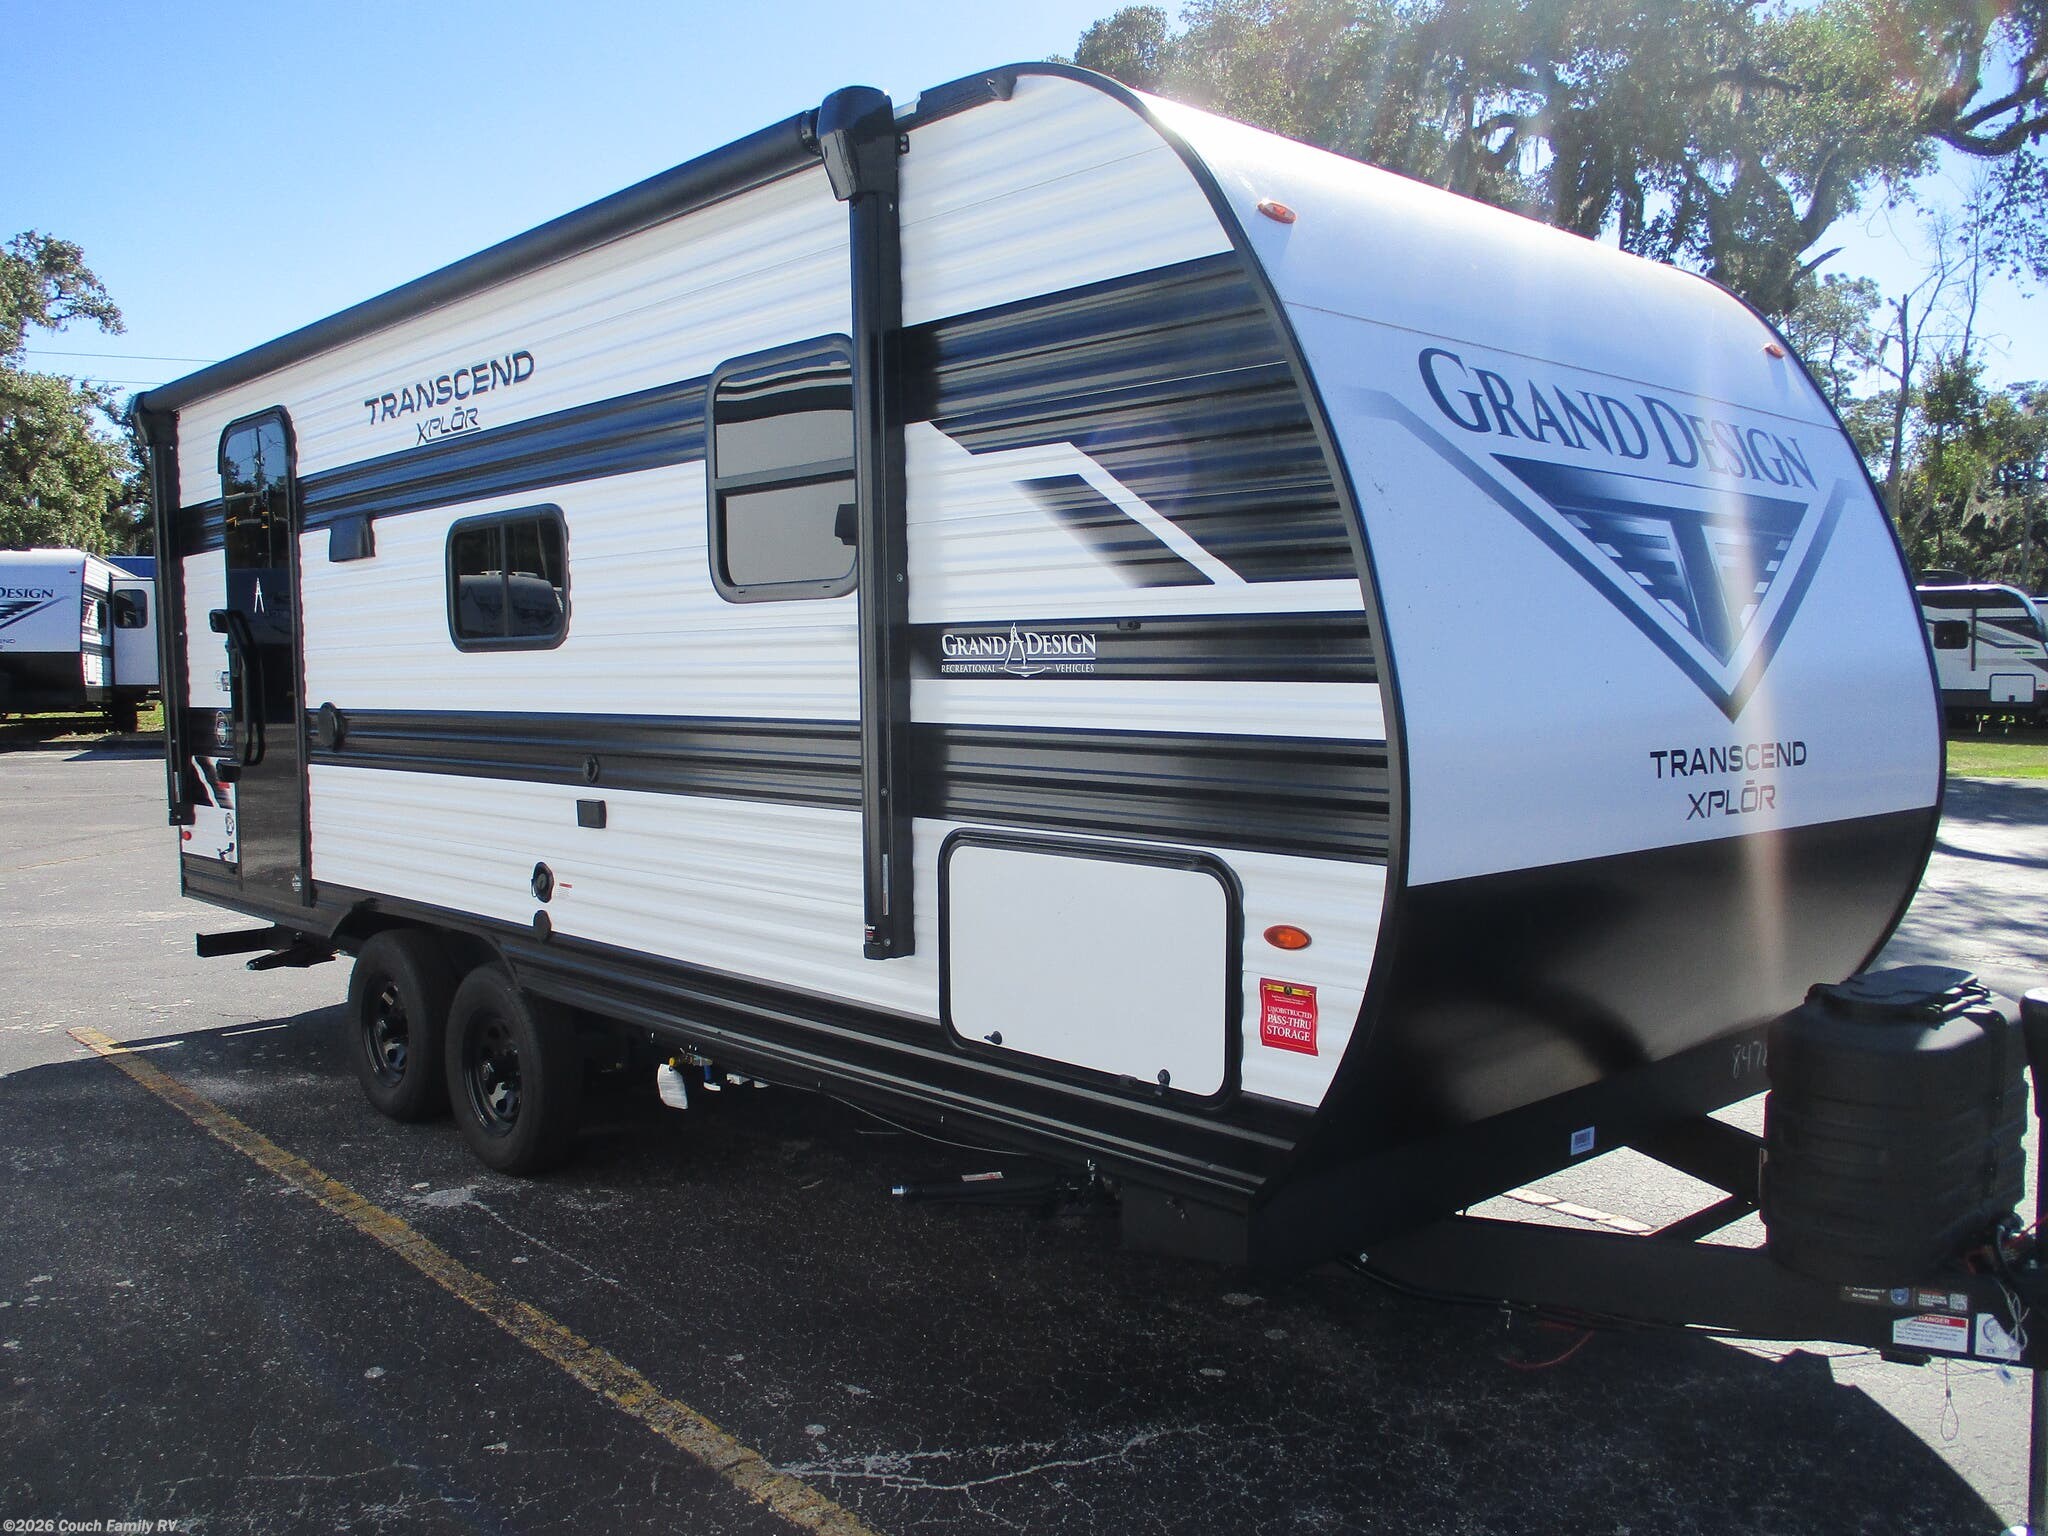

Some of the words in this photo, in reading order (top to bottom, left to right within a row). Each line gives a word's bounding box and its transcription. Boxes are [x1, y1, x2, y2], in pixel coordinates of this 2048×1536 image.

[364, 350, 535, 426] TRANSCEND
[1418, 347, 1649, 460] GRAND
[1636, 393, 1819, 491] DESIGN
[941, 634, 1007, 656] GRAND
[1024, 632, 1096, 655] DESIGN
[941, 664, 997, 673] RECREATIONAL
[1055, 664, 1095, 673] VEHICLES
[1649, 741, 1807, 779] TRANSCEND
[1267, 1013, 1312, 1030] PASS-THRU
[1266, 1024, 1311, 1042] STORAGE
[1918, 1315, 1951, 1325] DANGER
